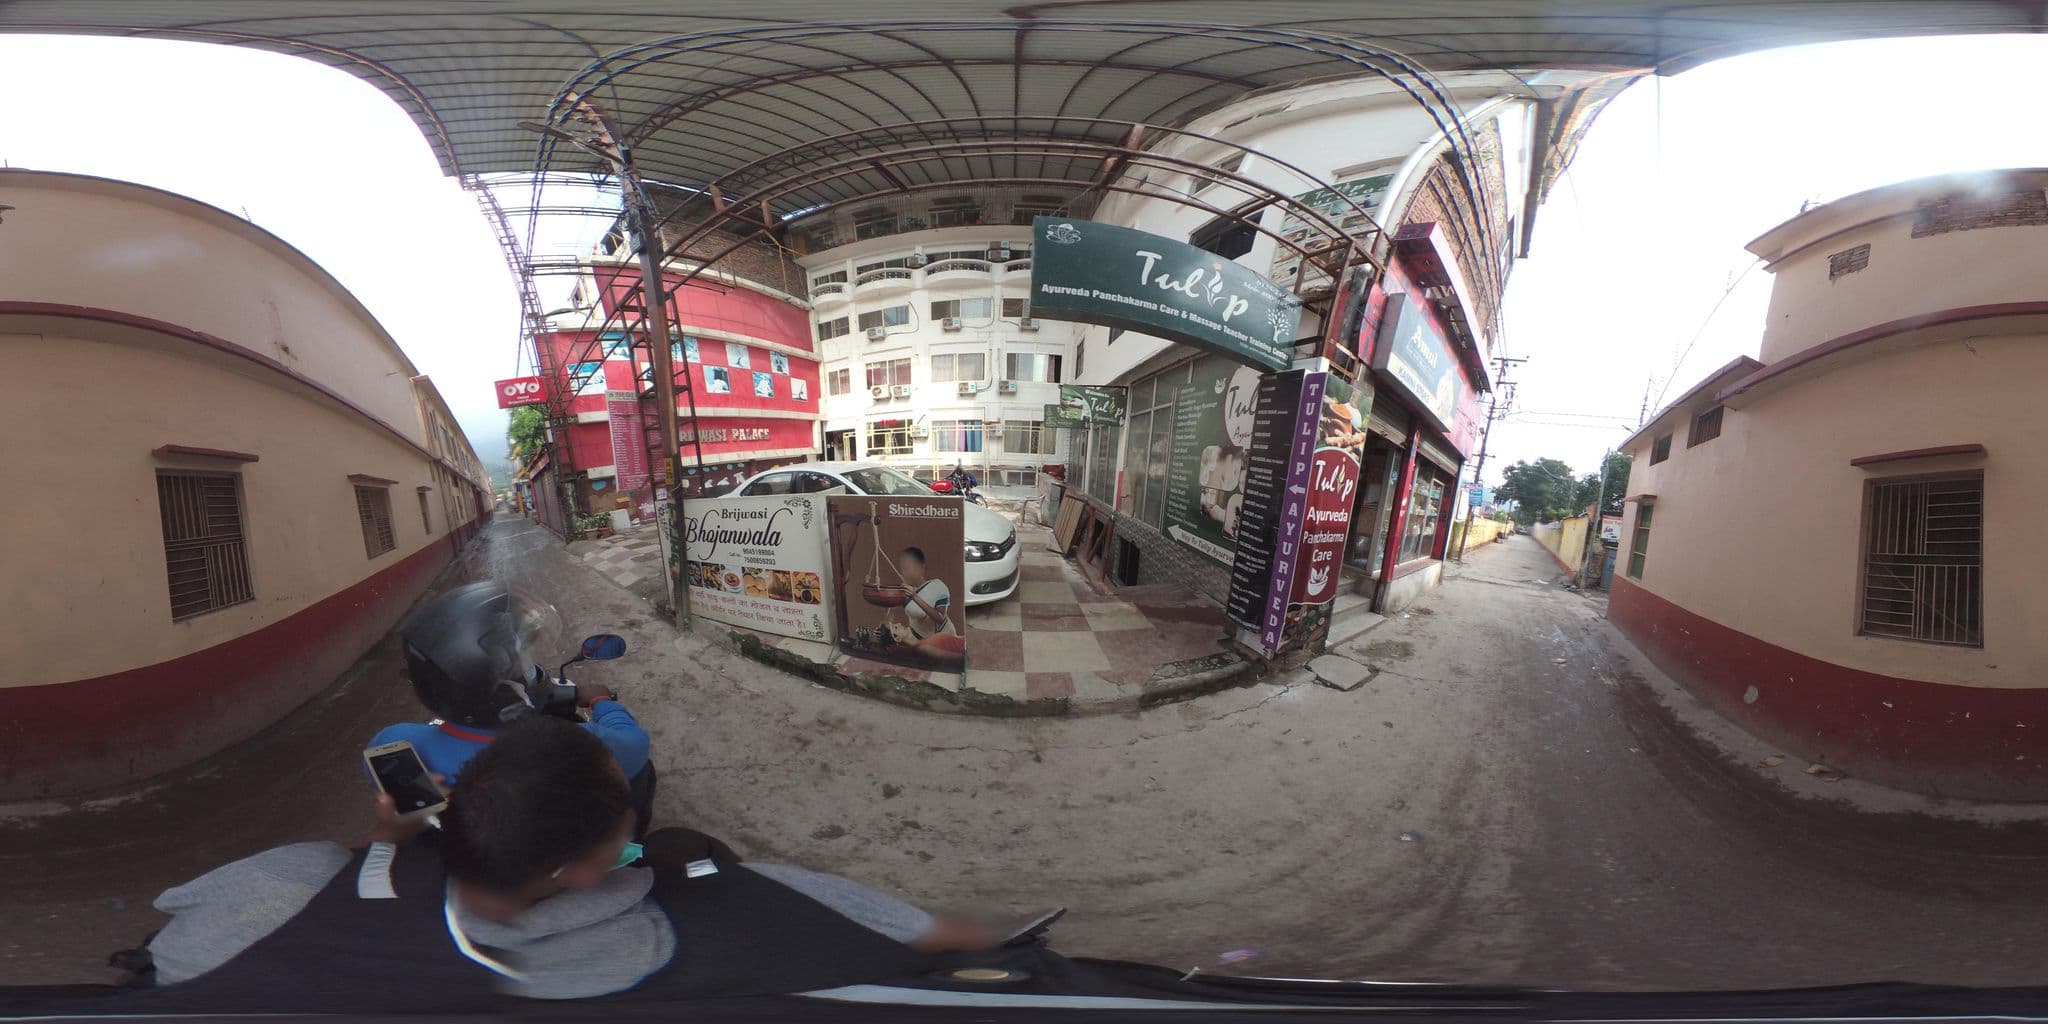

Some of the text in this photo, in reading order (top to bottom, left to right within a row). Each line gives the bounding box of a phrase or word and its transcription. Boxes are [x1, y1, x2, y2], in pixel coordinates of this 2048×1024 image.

[1135, 250, 1249, 322] Tulip
[1041, 284, 1090, 297] Ayurveda
[1092, 289, 1158, 311] Panchakarma
[1159, 304, 1180, 317] Care
[1181, 310, 1189, 319] &
[1188, 312, 1222, 332] Massage
[1223, 325, 1249, 341] Teacher
[1249, 336, 1273, 353] Training
[503, 382, 540, 396] OYO
[1090, 397, 1124, 418] Tulip
[1229, 384, 1259, 420] Tul
[731, 428, 769, 441] PALACE
[1295, 383, 1320, 476] TULIP
[1315, 458, 1354, 502] Tulip
[721, 508, 768, 521] Brijwasi
[888, 503, 960, 517] Shirodhara
[1306, 506, 1349, 530] Ayurveda
[684, 507, 793, 561] Bhojanwala
[1303, 530, 1345, 545] Panchakarma
[1312, 548, 1333, 563] Care
[1265, 502, 1299, 644] AYURVEDA
